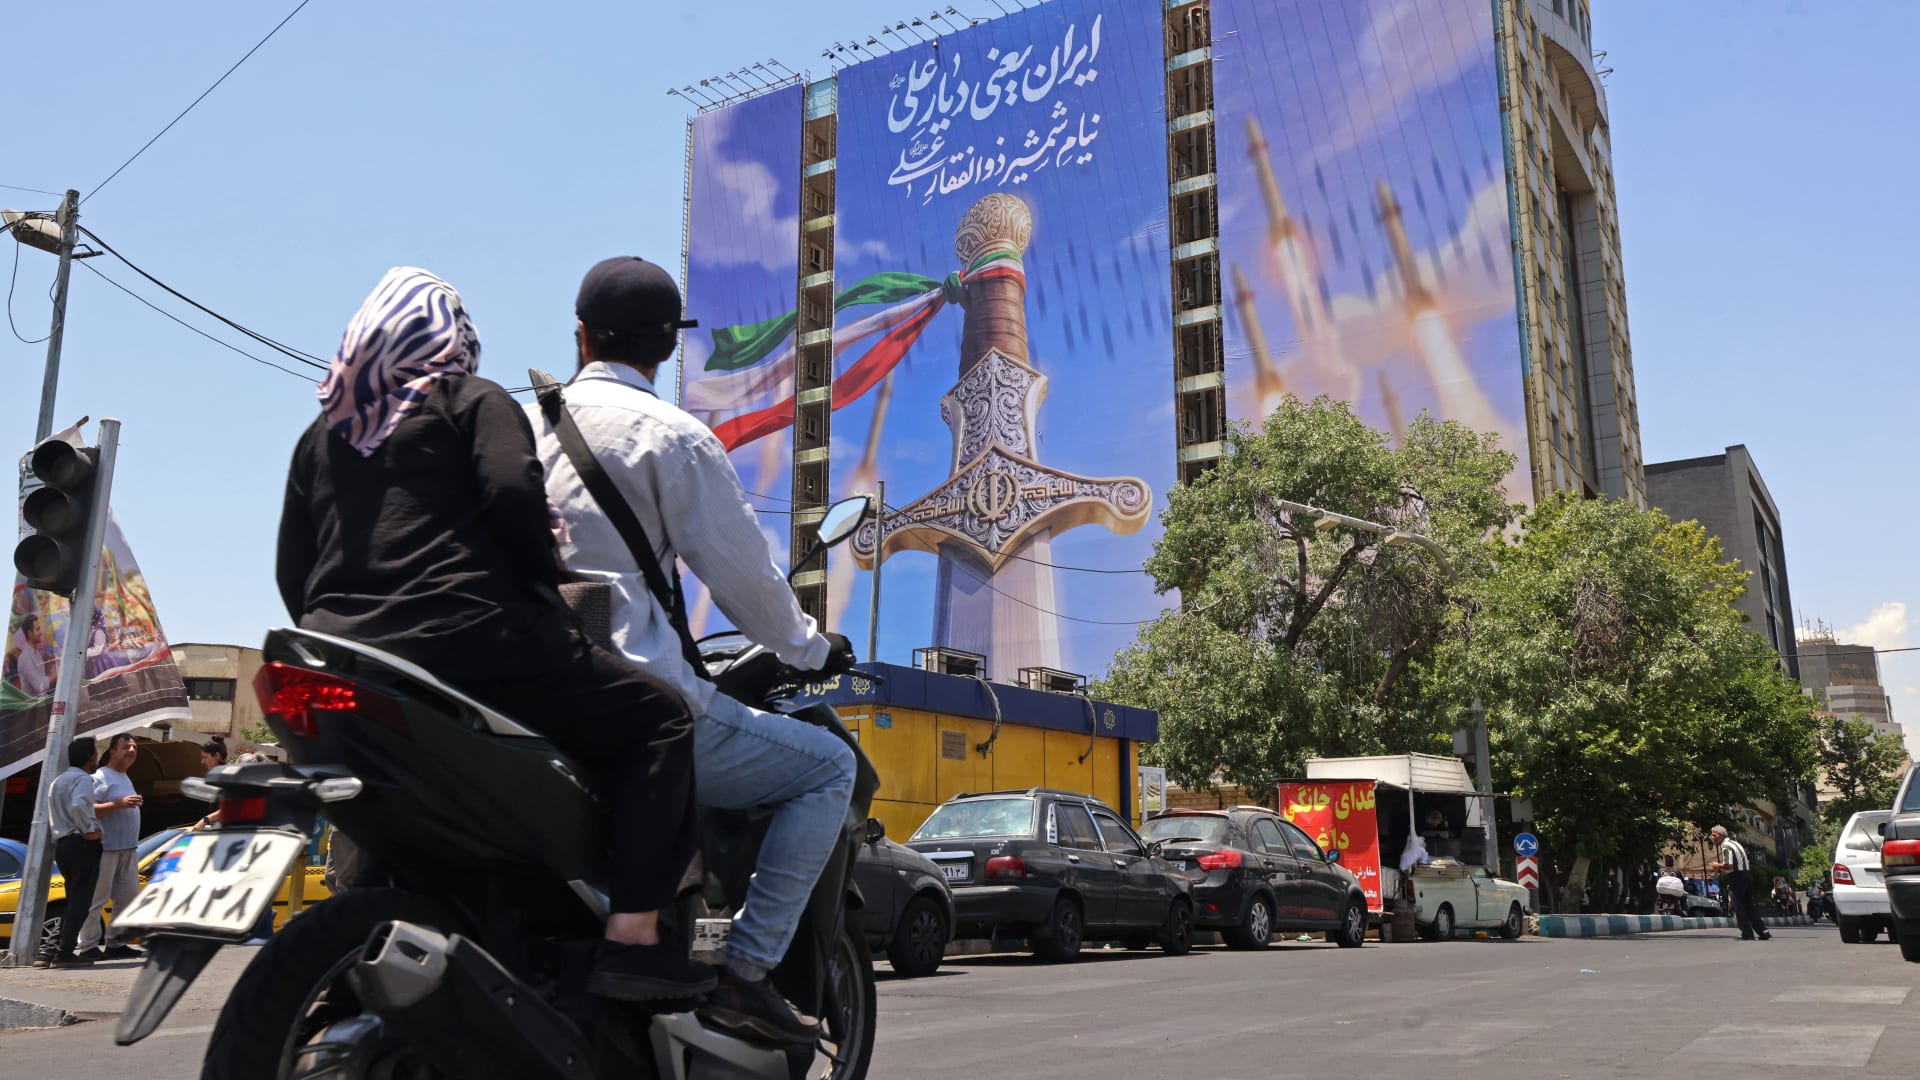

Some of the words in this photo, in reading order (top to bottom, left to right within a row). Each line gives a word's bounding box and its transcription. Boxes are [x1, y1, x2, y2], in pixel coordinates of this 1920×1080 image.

[888, 58, 938, 133] علی
[970, 45, 1033, 120] یعنی
[1022, 14, 1102, 102] ایران
[1284, 785, 1330, 822] خانگی
[1335, 784, 1375, 819] غذای
